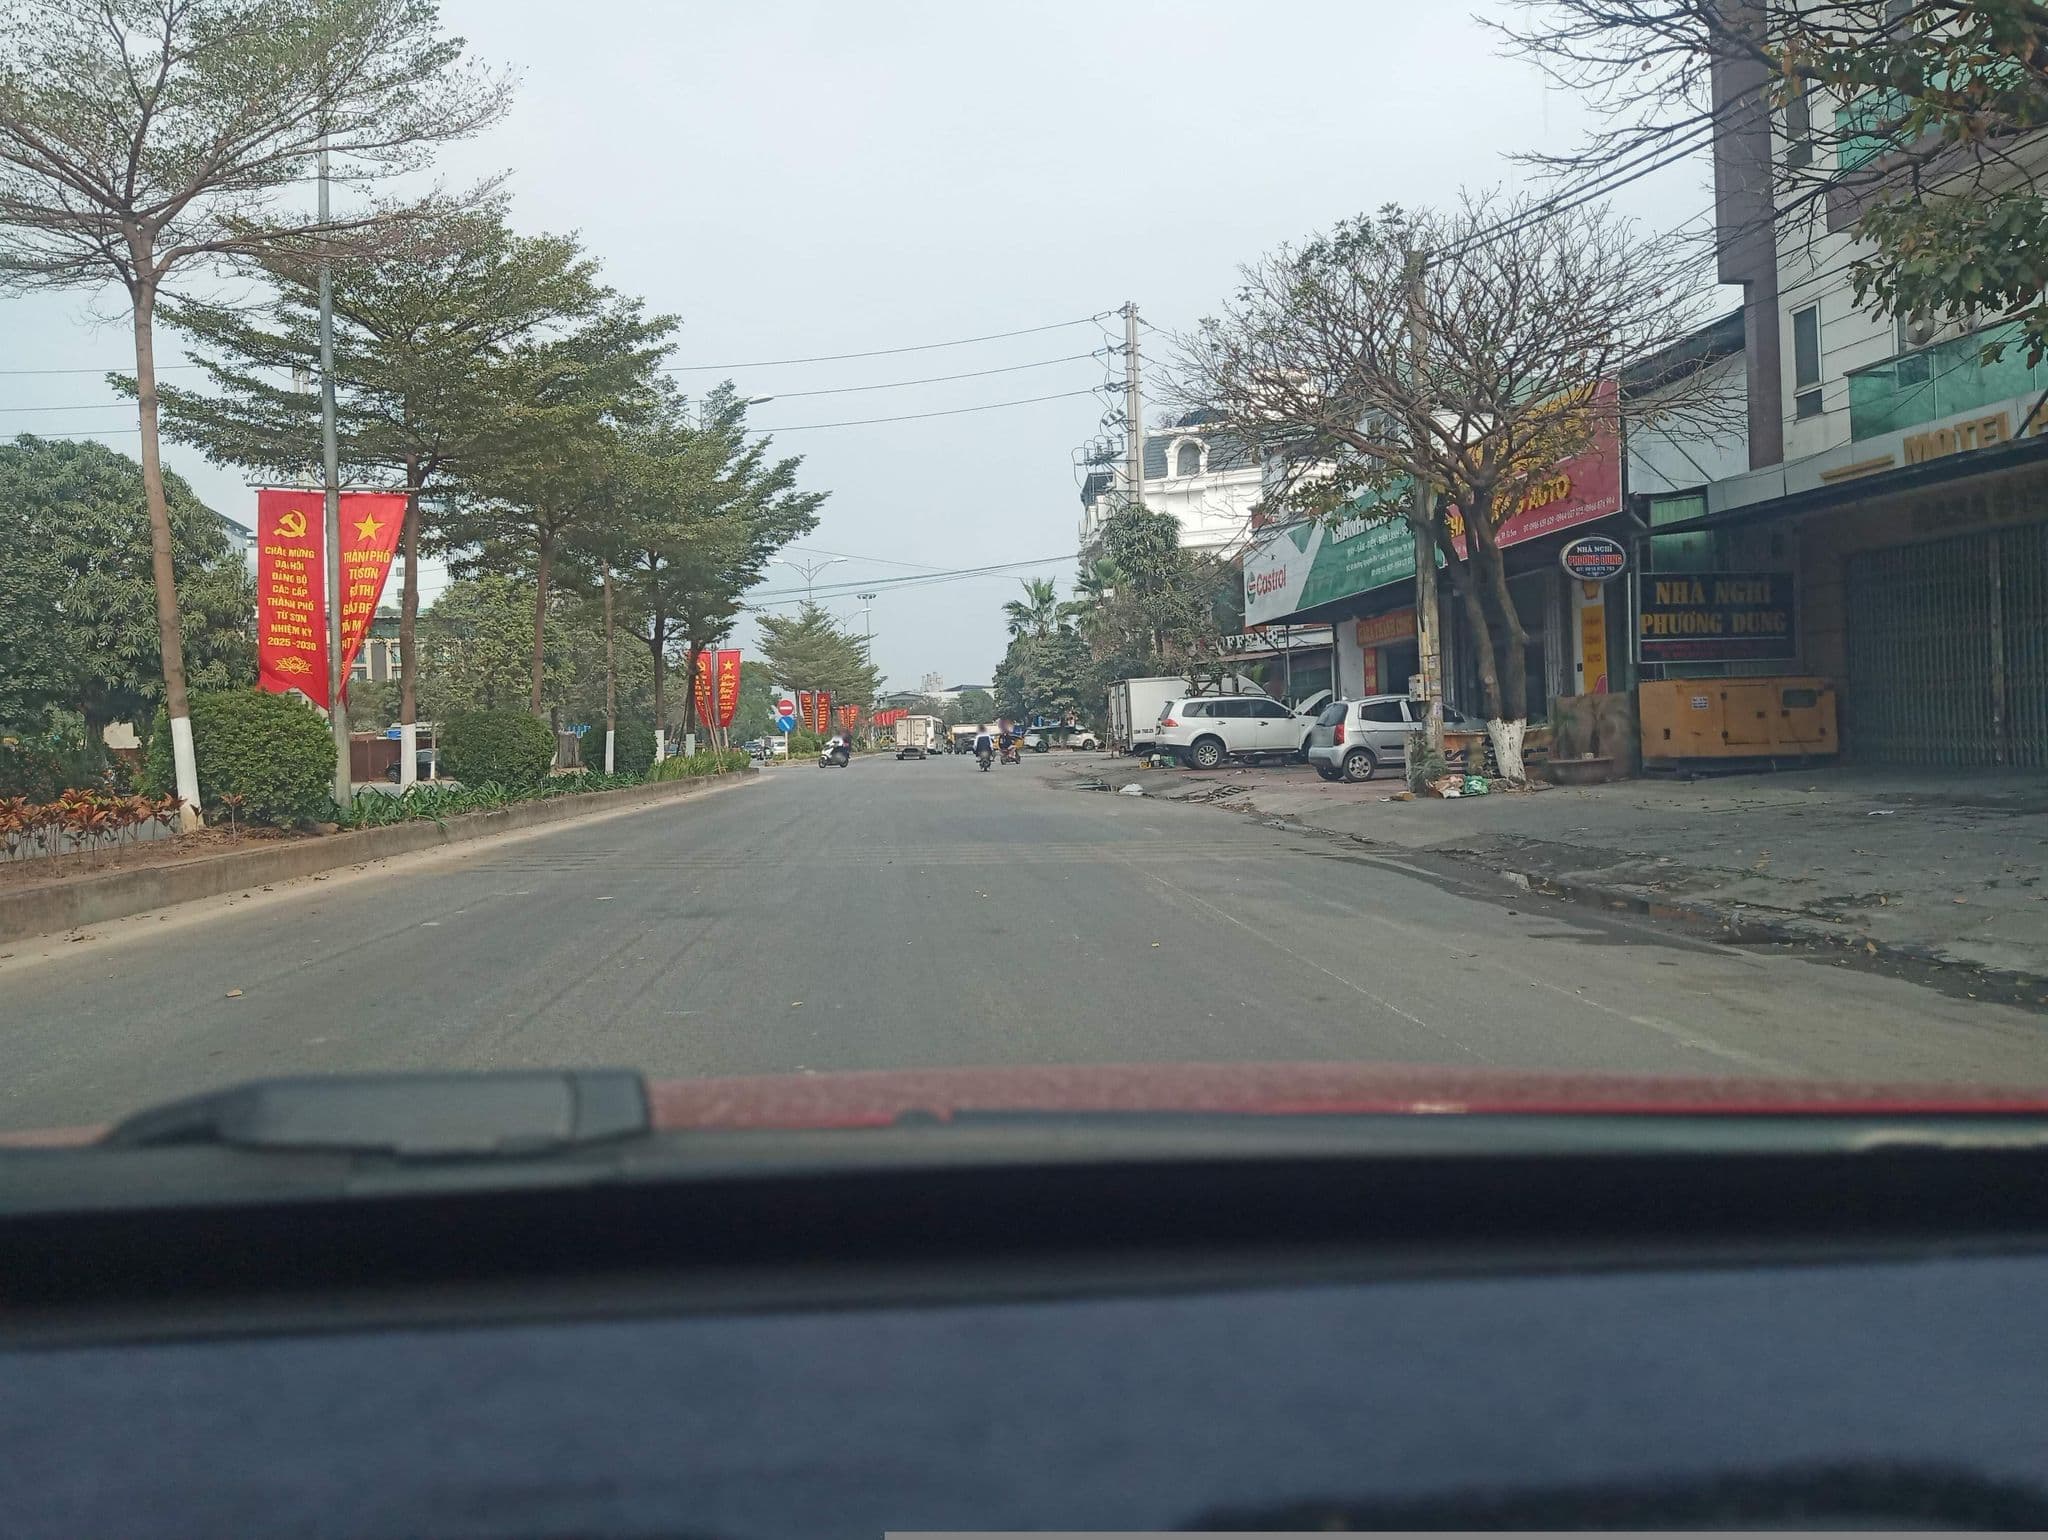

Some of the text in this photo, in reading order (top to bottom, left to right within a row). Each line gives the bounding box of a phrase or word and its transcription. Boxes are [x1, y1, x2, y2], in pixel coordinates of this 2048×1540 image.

[1528, 475, 1571, 511] AUTO
[1577, 544, 1613, 553] NHÀ NGHỈ
[1257, 564, 1287, 596] Castrol
[1656, 578, 1771, 604] NHÀ NGHỈ
[267, 596, 315, 611] THÀNH PHỐ
[276, 609, 307, 624] TỪ SƠN
[1640, 611, 1787, 634] PHƯƠNG DUNG
[271, 624, 300, 636] NHIỆM
